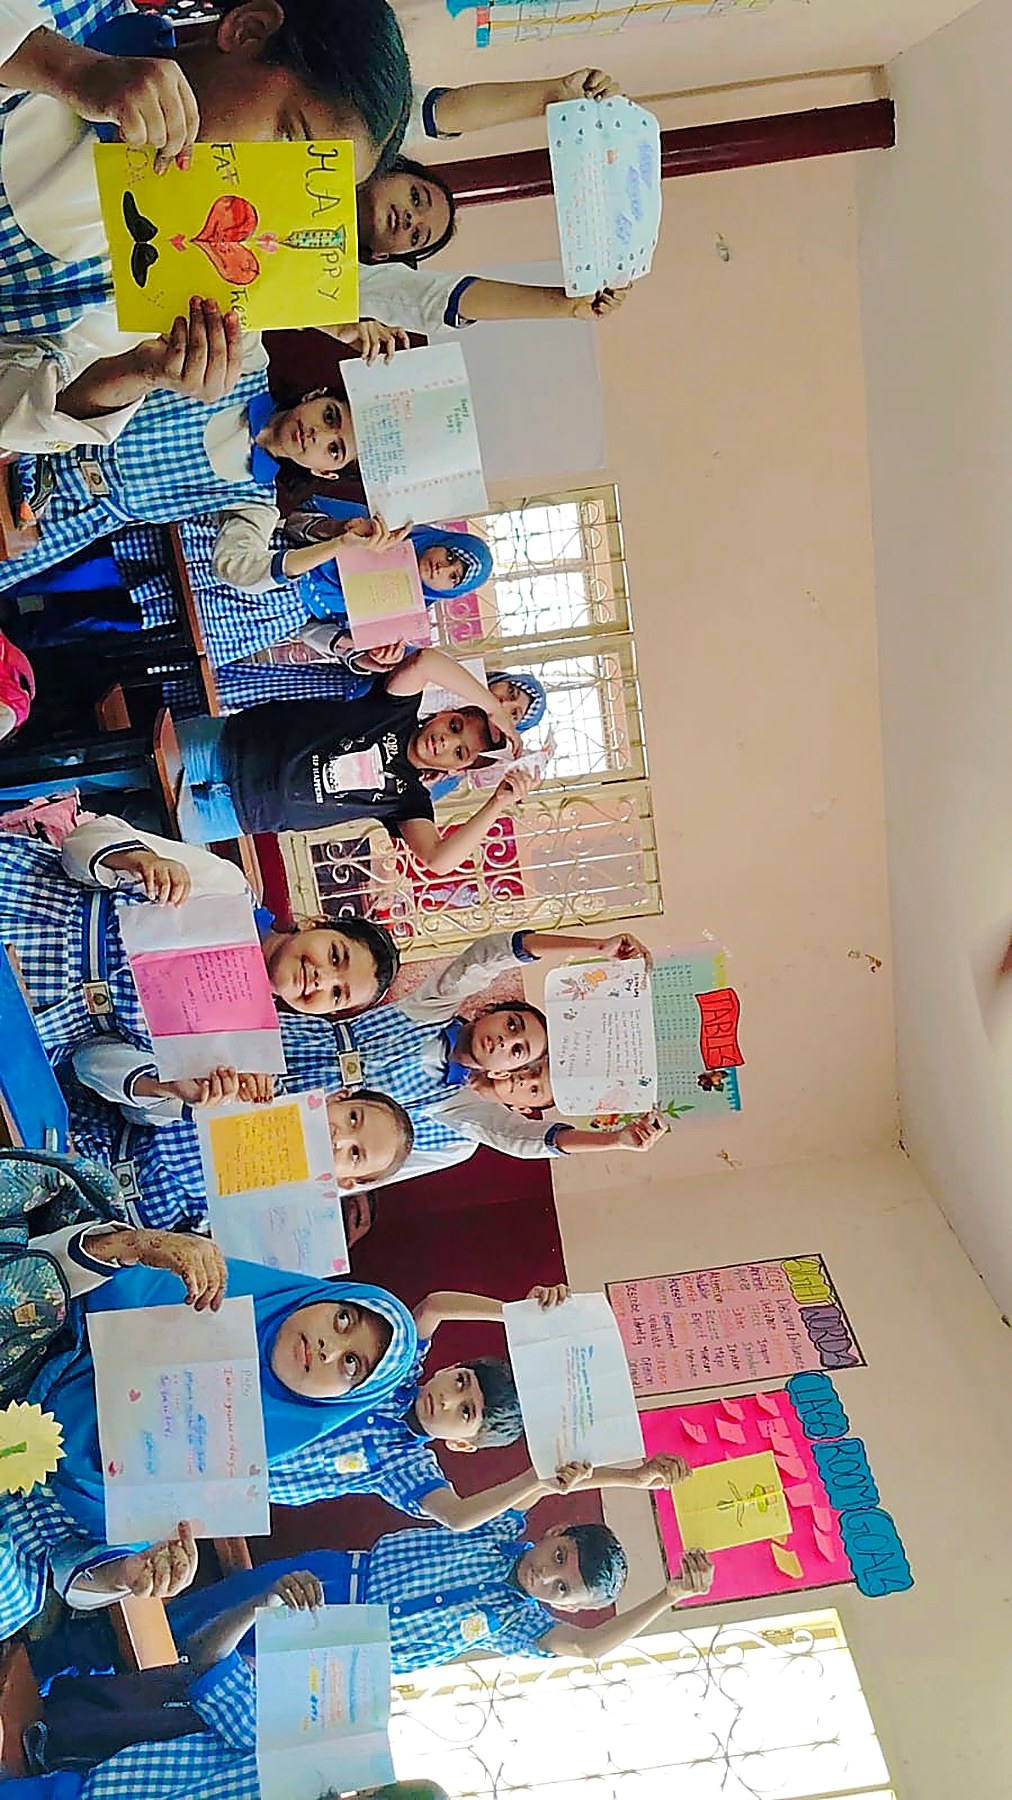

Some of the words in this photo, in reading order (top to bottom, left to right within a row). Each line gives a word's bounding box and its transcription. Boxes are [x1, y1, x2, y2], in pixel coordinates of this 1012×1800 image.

[701, 991, 738, 1067] TABLES
[799, 1305, 859, 1368] WORDS
[793, 1373, 844, 1437] CLASS
[825, 1440, 874, 1508] ROOM
[845, 1510, 907, 1597] GOALS
